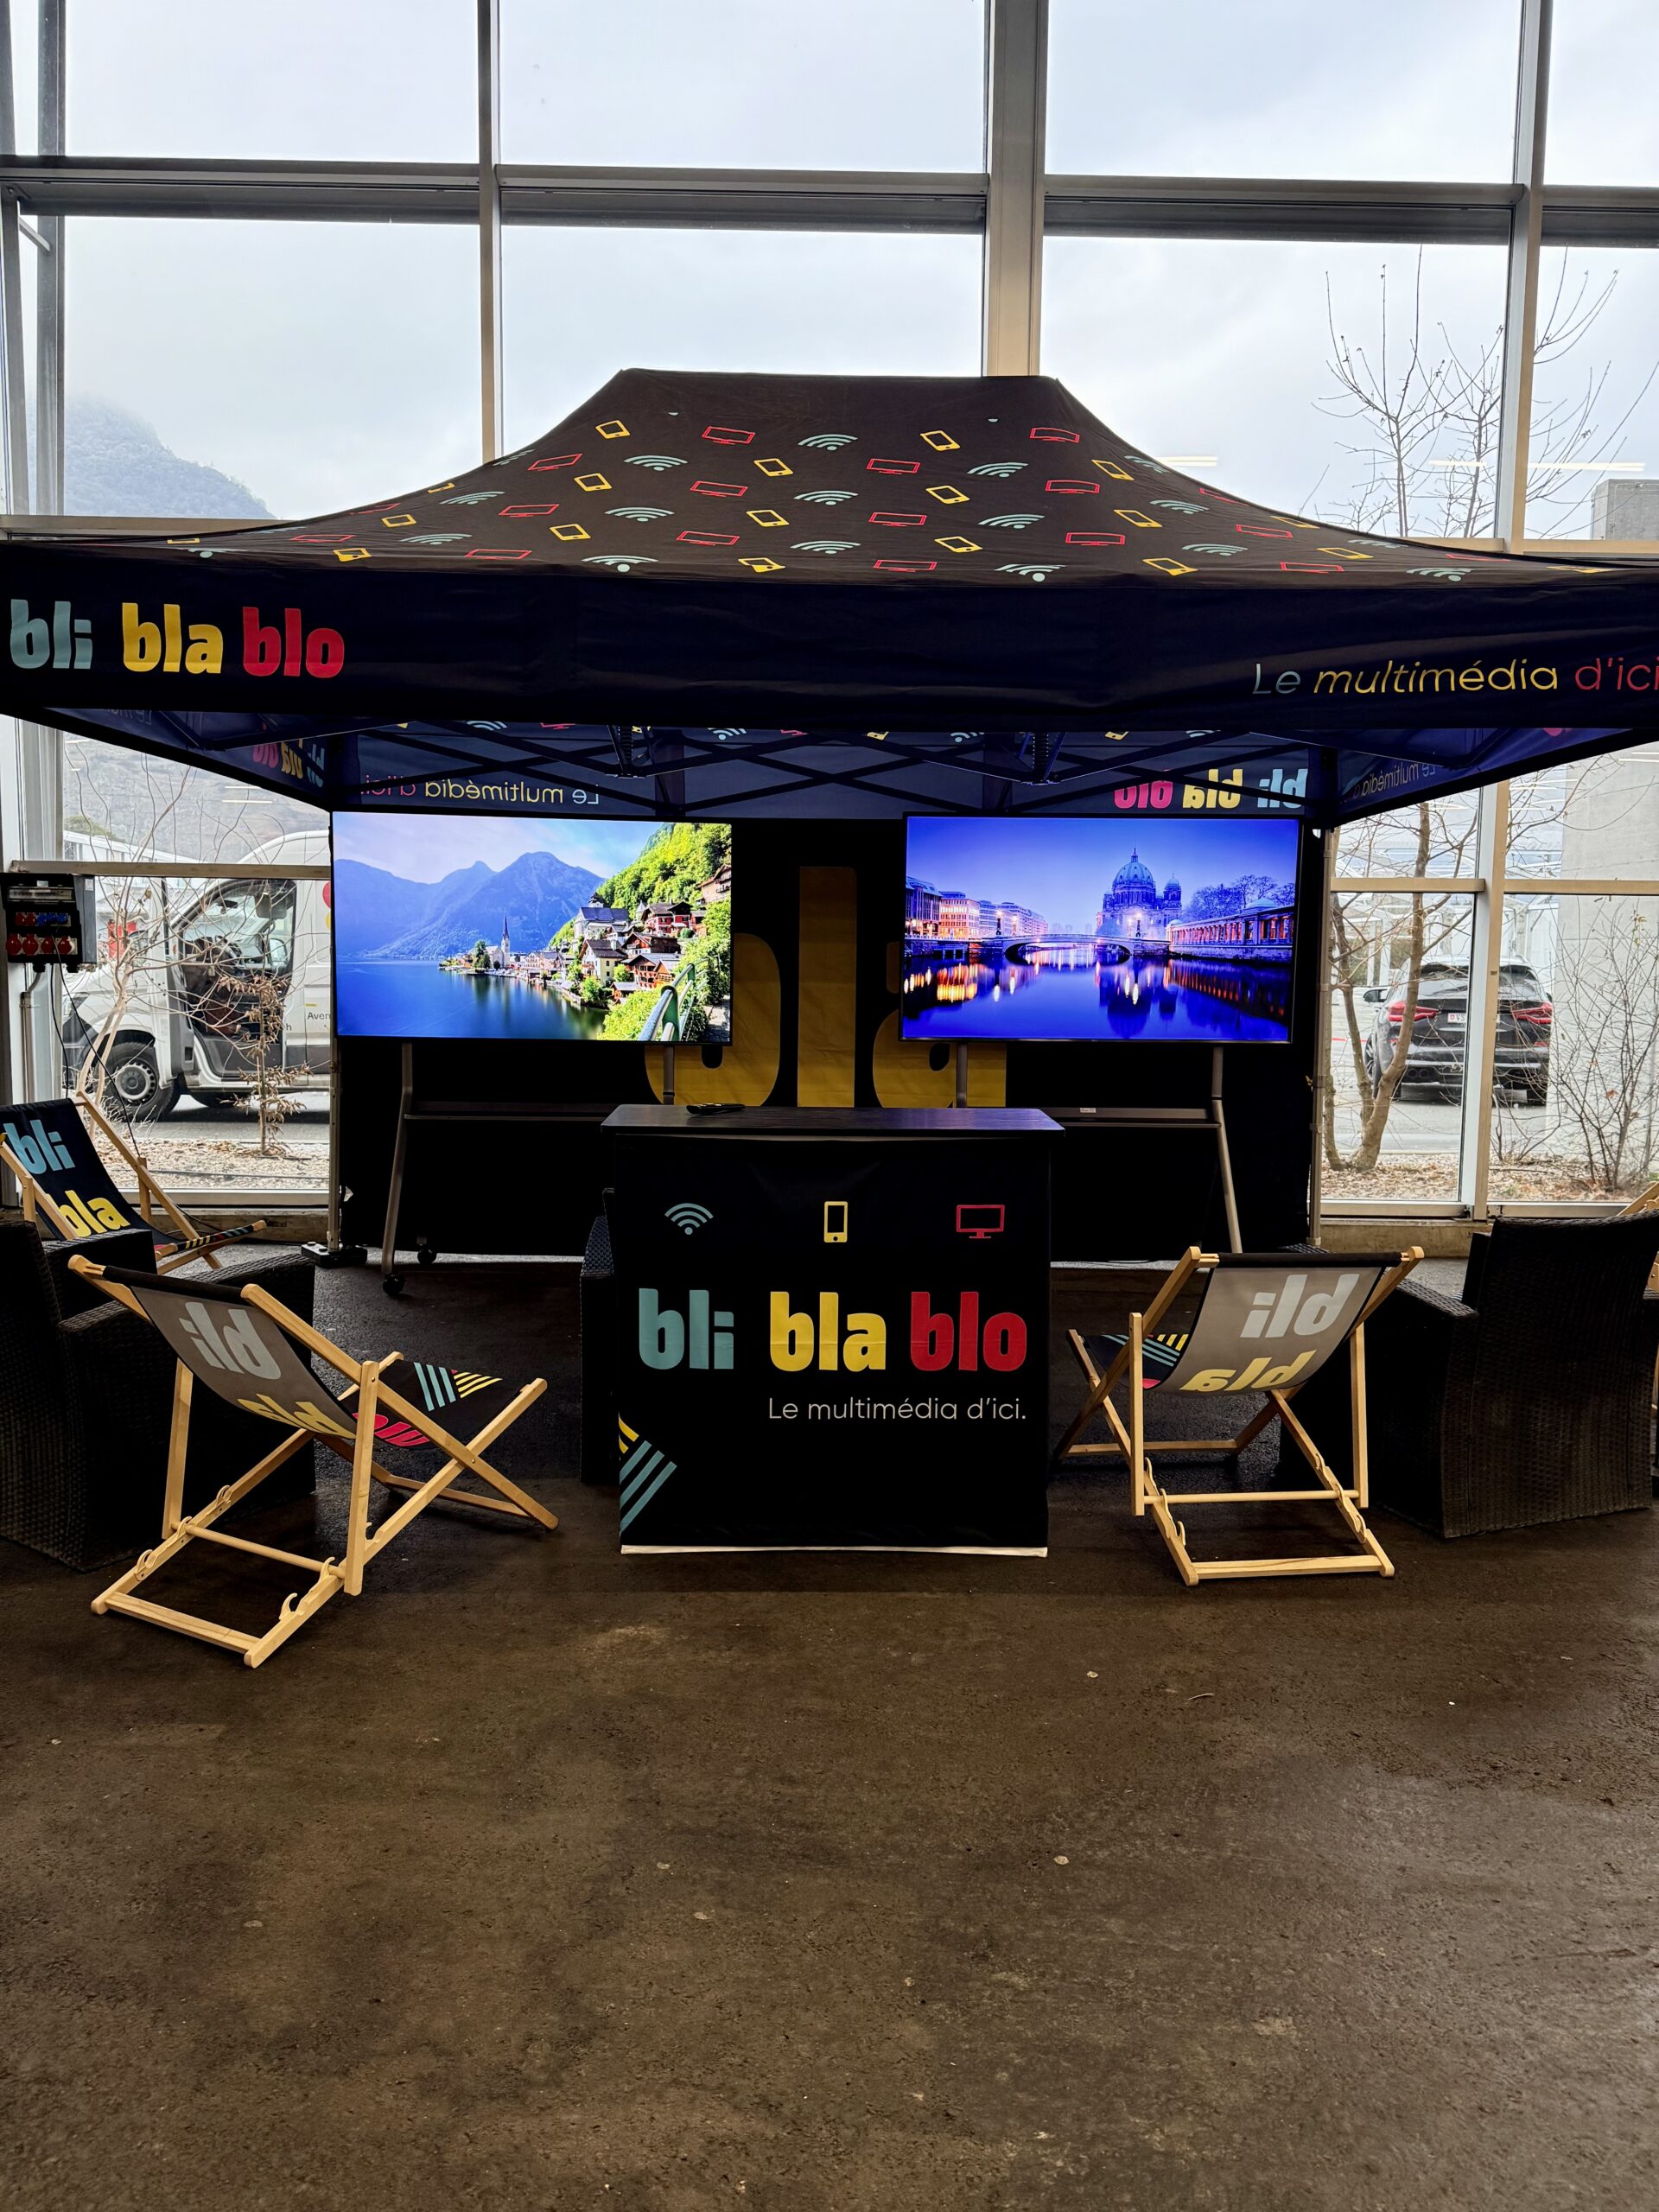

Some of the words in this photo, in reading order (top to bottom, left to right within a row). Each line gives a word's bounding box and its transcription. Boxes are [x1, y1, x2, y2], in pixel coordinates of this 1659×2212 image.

[10, 598, 93, 670] bli
[122, 602, 224, 675] bla
[242, 607, 346, 679] blo
[1253, 663, 1301, 695] Le
[1313, 659, 1558, 694] multimédia
[3, 1119, 76, 1174] bli
[44, 1189, 130, 1237] bla
[639, 1287, 734, 1370] bli
[770, 1291, 887, 1372] bla
[910, 1291, 1027, 1372] blo
[769, 1397, 798, 1419] Le
[808, 1396, 958, 1420] multimédia
[967, 1397, 1027, 1420] d'ici.
